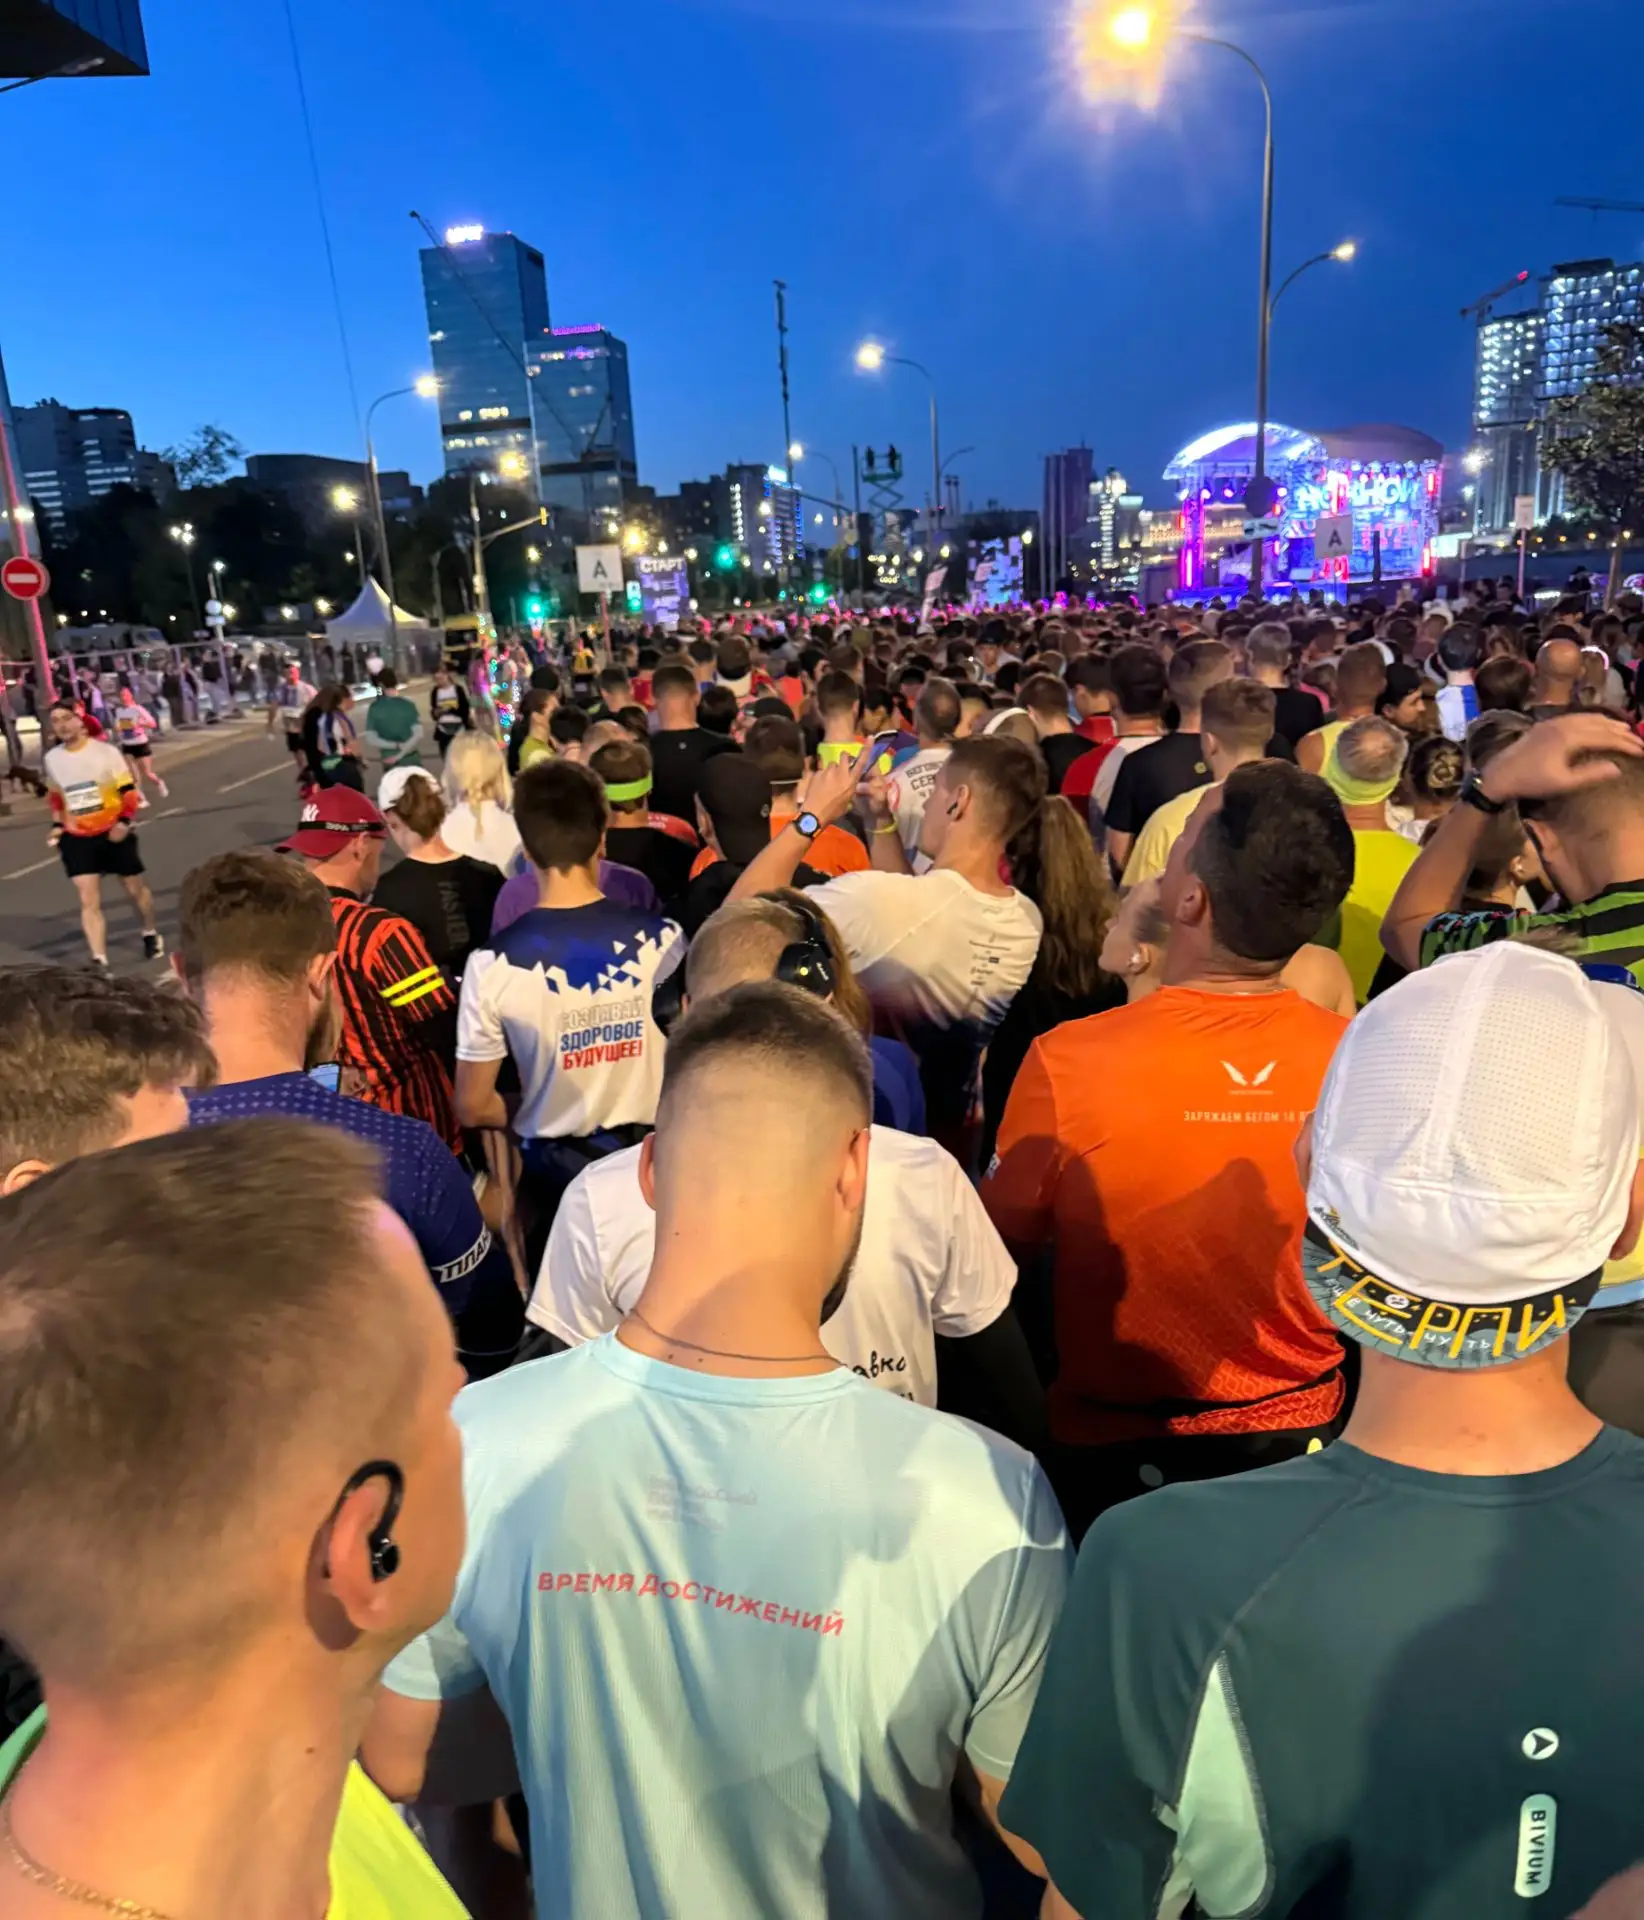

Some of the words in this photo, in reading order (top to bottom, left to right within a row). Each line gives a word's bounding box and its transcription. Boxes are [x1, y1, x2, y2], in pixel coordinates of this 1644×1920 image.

[640, 557, 683, 574] СТАРТ
[560, 1020, 644, 1053] ЗДОРОВОЕ
[563, 1039, 642, 1070] БУДУЩЕЕ!
[1183, 1109, 1241, 1122] ЗАРЯЖАЕМ
[1245, 1110, 1279, 1122] БЕГОМ
[1316, 1238, 1566, 1359] ТЕРПИ
[537, 1571, 635, 1593] ВРЕМЯ
[637, 1572, 845, 1636] ДОСТИЖЕНИЙ
[1526, 1810, 1547, 1885] BIVIUM
